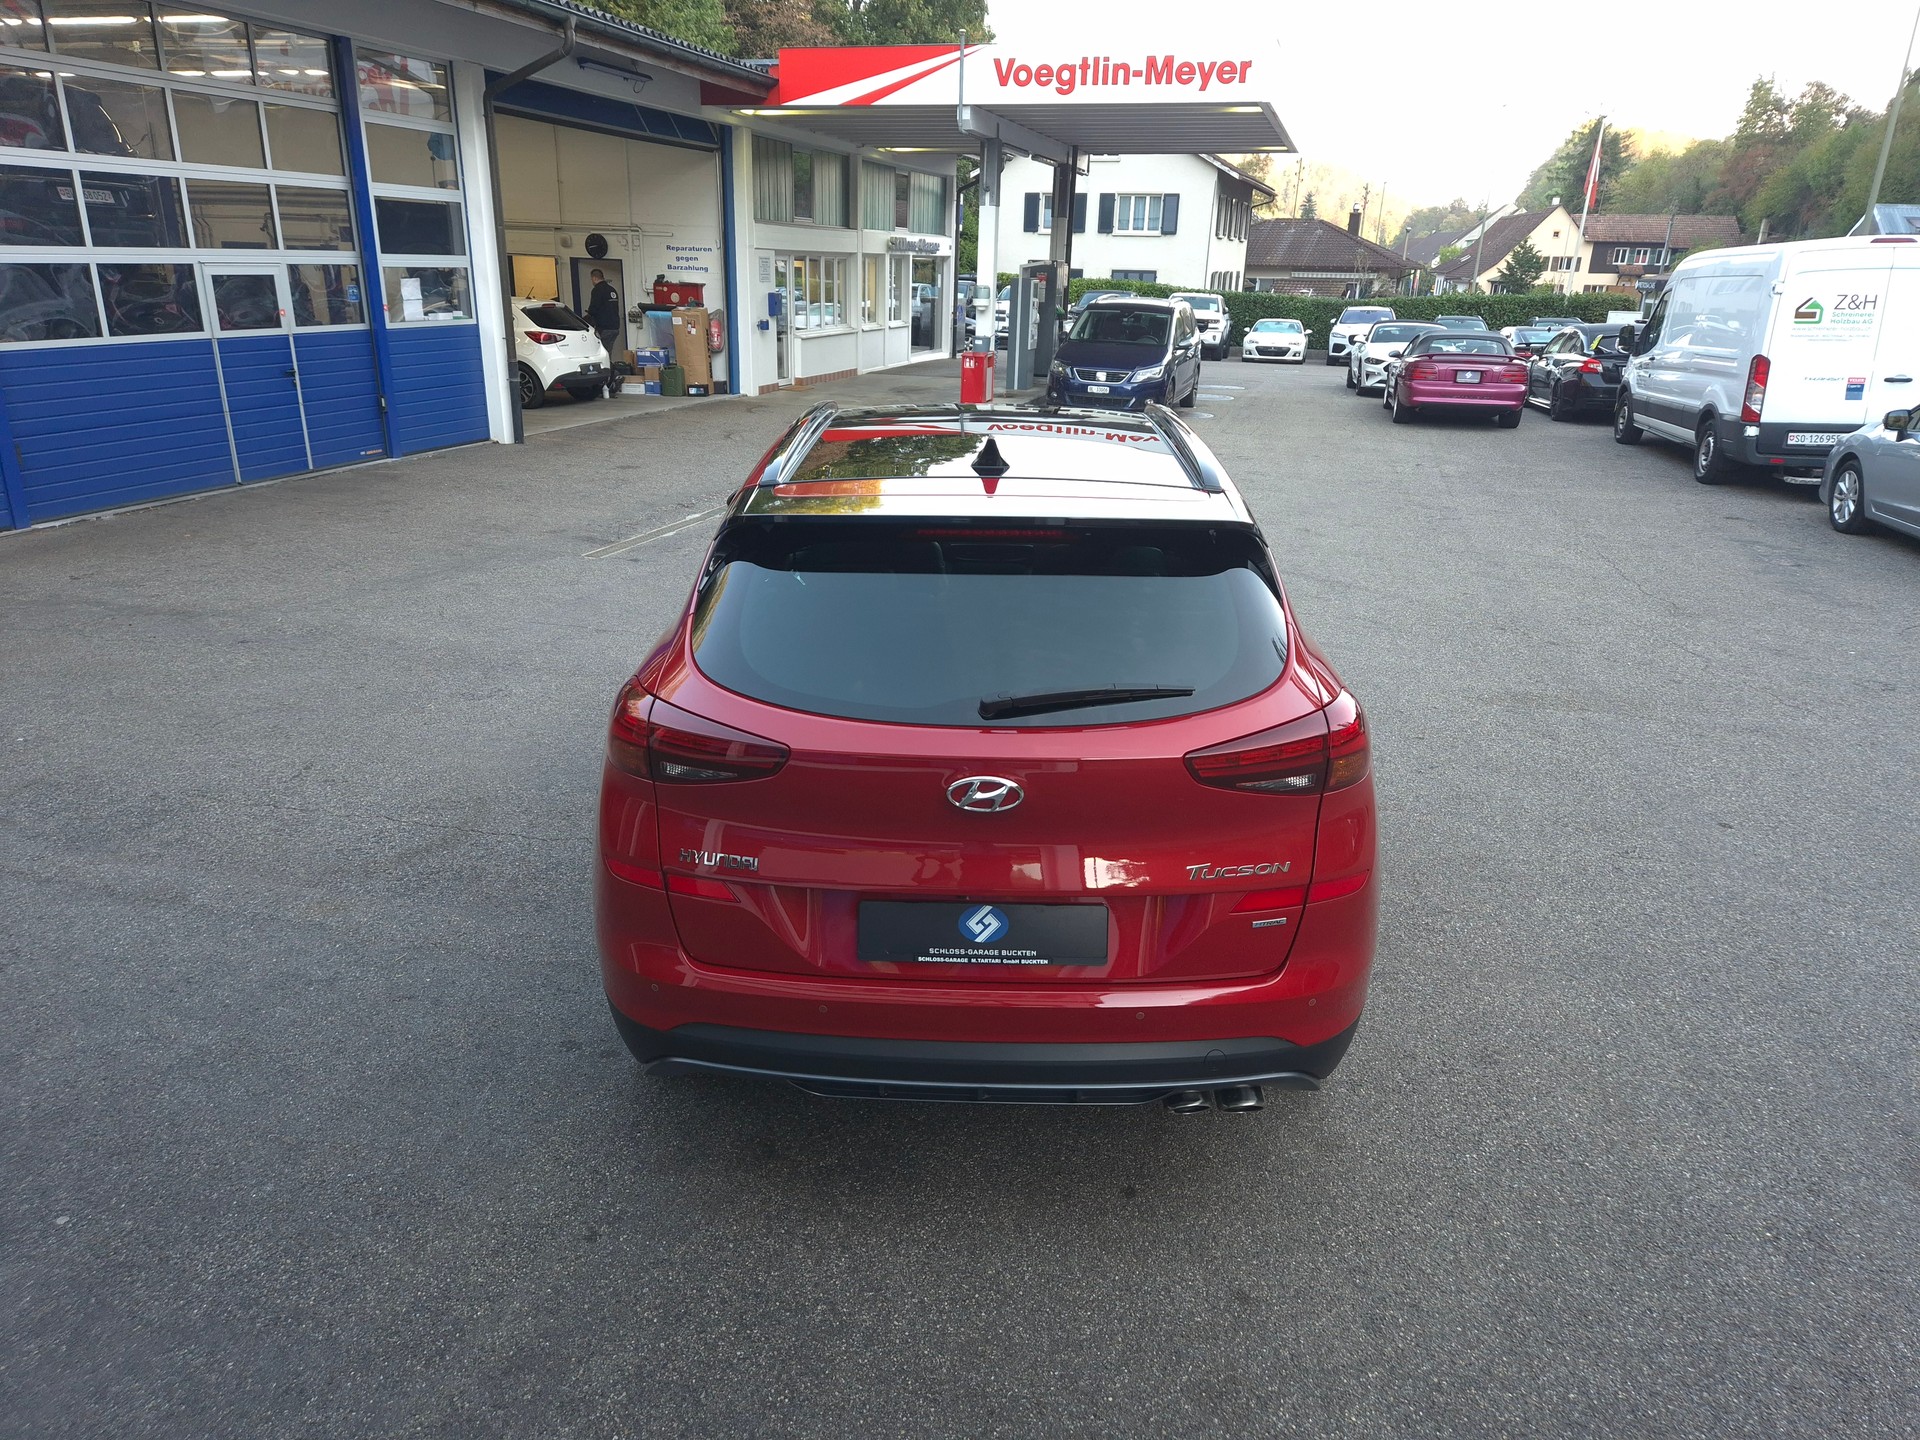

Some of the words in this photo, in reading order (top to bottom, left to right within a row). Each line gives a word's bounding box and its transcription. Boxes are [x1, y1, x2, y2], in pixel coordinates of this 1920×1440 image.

[993, 55, 1252, 96] Voegtlin-Meyer
[666, 244, 713, 252] Reparaturen
[667, 263, 709, 273] Barzahlung
[1834, 294, 1878, 310] Z&H
[679, 847, 759, 872] HYUNDAI
[1186, 861, 1291, 880] TUCSON
[928, 947, 1000, 956] SCHLOSS-GARAGE
[1001, 949, 1037, 957] BUCKTEN
